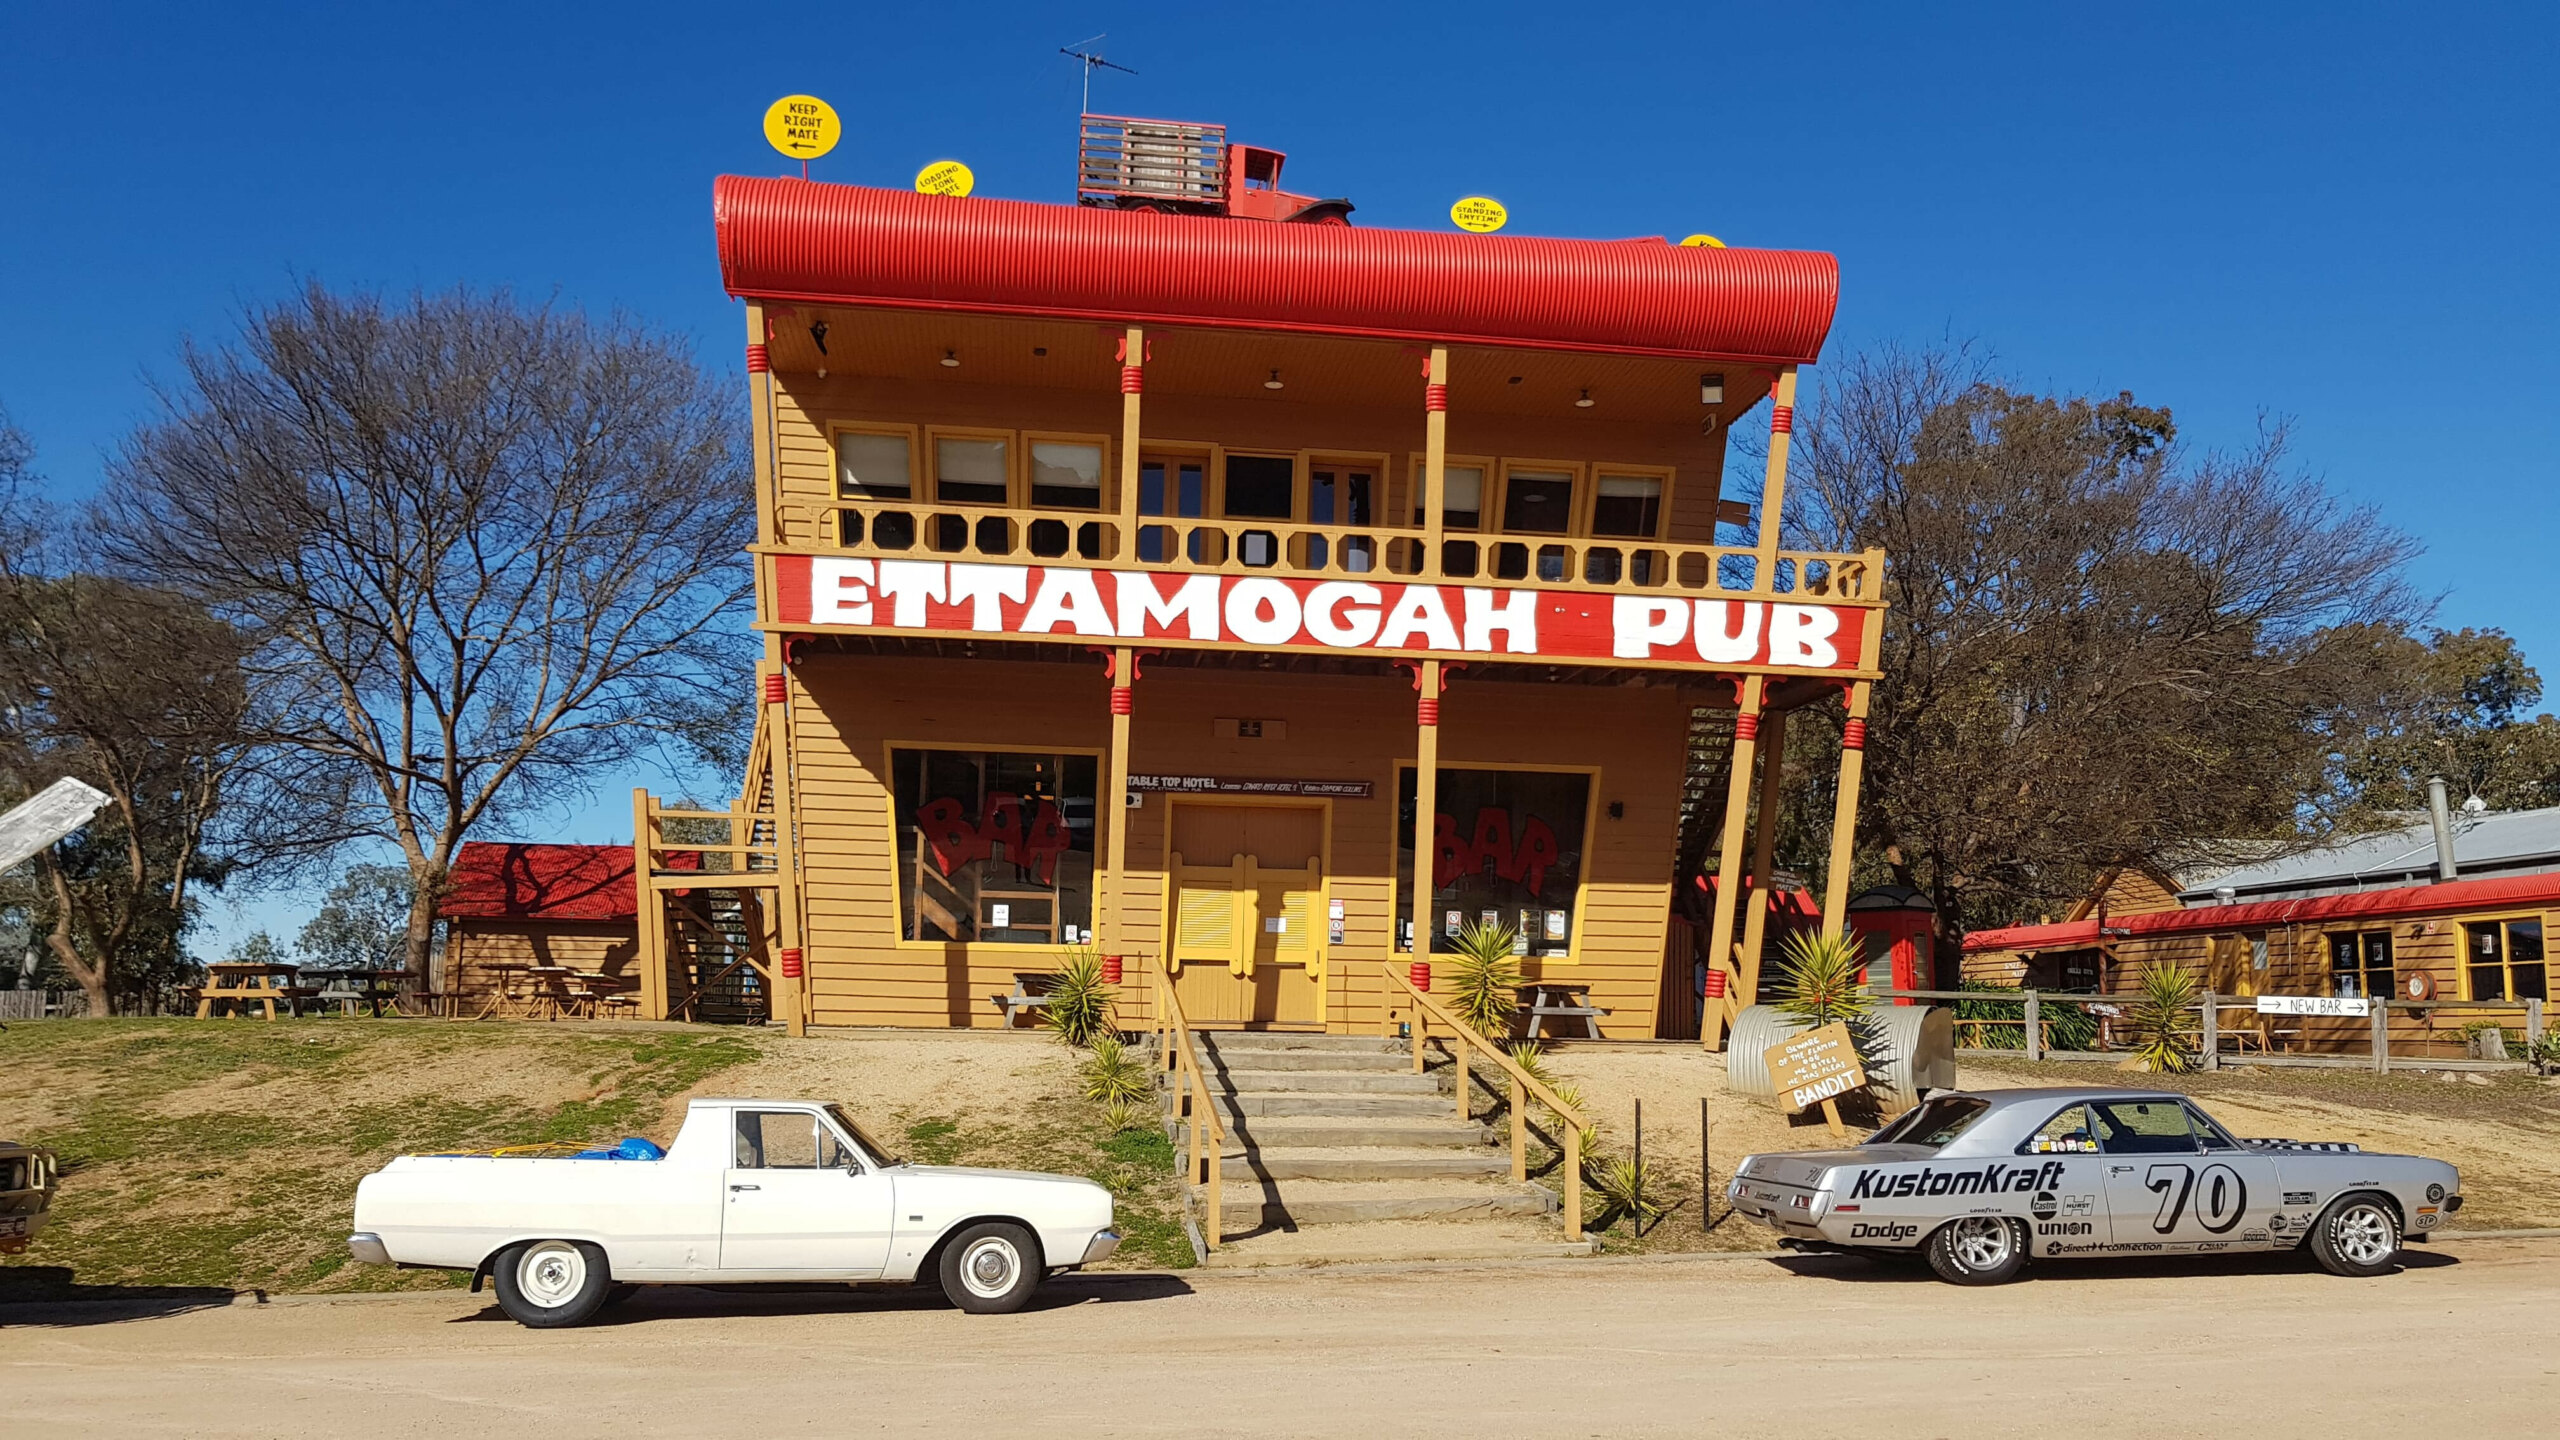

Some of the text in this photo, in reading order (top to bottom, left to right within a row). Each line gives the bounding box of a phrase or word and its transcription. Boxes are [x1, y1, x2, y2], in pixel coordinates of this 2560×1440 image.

[789, 103, 818, 115] KEEP
[784, 115, 823, 128] RIGHT
[787, 128, 819, 140] MATE
[919, 165, 959, 187] LOADING
[933, 175, 955, 190] ZONE
[1456, 206, 1502, 216] STANDING
[810, 556, 1839, 668] ETTAMOGAH PUB
[1127, 776, 1217, 788] TABLE TOP HOTEL
[916, 792, 1071, 885] BAR
[1413, 808, 1558, 898] BAR
[2290, 999, 2342, 1014] NEW BAR
[1785, 1036, 1820, 1054] BEWARE
[1778, 1040, 1838, 1067] OF THE FLAMIN
[1802, 1054, 1820, 1065] DOG
[1802, 1071, 1819, 1080] HAS
[1822, 1061, 1846, 1074] FLEAS
[1811, 1056, 1837, 1070] BITES
[1793, 1070, 1856, 1107] BANDIT
[1849, 1161, 2066, 1199] KustomKraft
[2033, 1201, 2057, 1211] Castrol
[2145, 1164, 2247, 1234] 70
[2418, 1216, 2434, 1225] STP
[1850, 1221, 1918, 1241] Dodge
[2038, 1222, 2092, 1236] union
[2063, 1243, 2092, 1252] direct
[2106, 1242, 2163, 1251] connection
